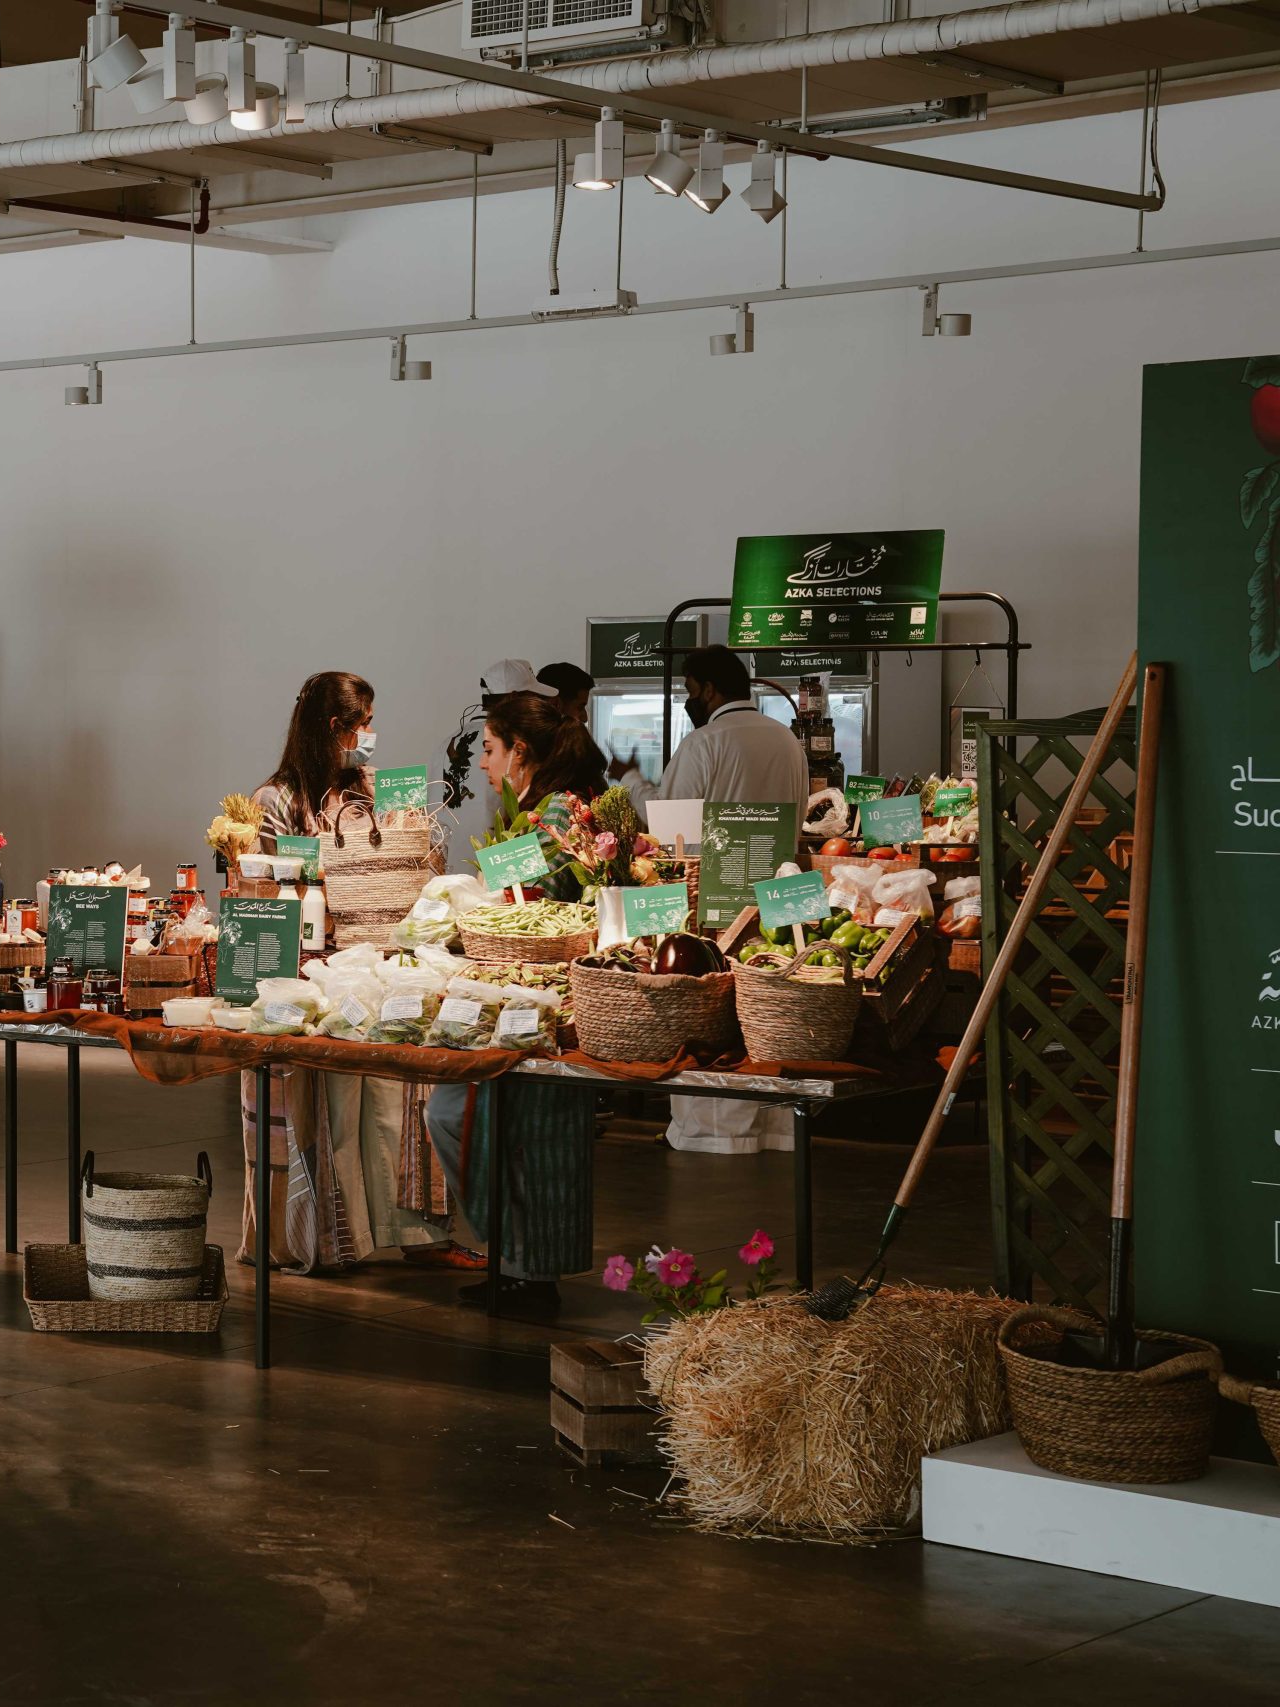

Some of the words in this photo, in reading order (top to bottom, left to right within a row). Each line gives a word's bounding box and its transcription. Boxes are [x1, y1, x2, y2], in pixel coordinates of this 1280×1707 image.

[784, 588, 813, 598] AZKA
[816, 586, 882, 597] SELECTIONS
[380, 778, 390, 788] 33
[868, 810, 880, 821] 10
[281, 845, 290, 854] 43
[488, 854, 502, 866] 13
[766, 890, 780, 900] 14
[633, 899, 645, 909] 13
